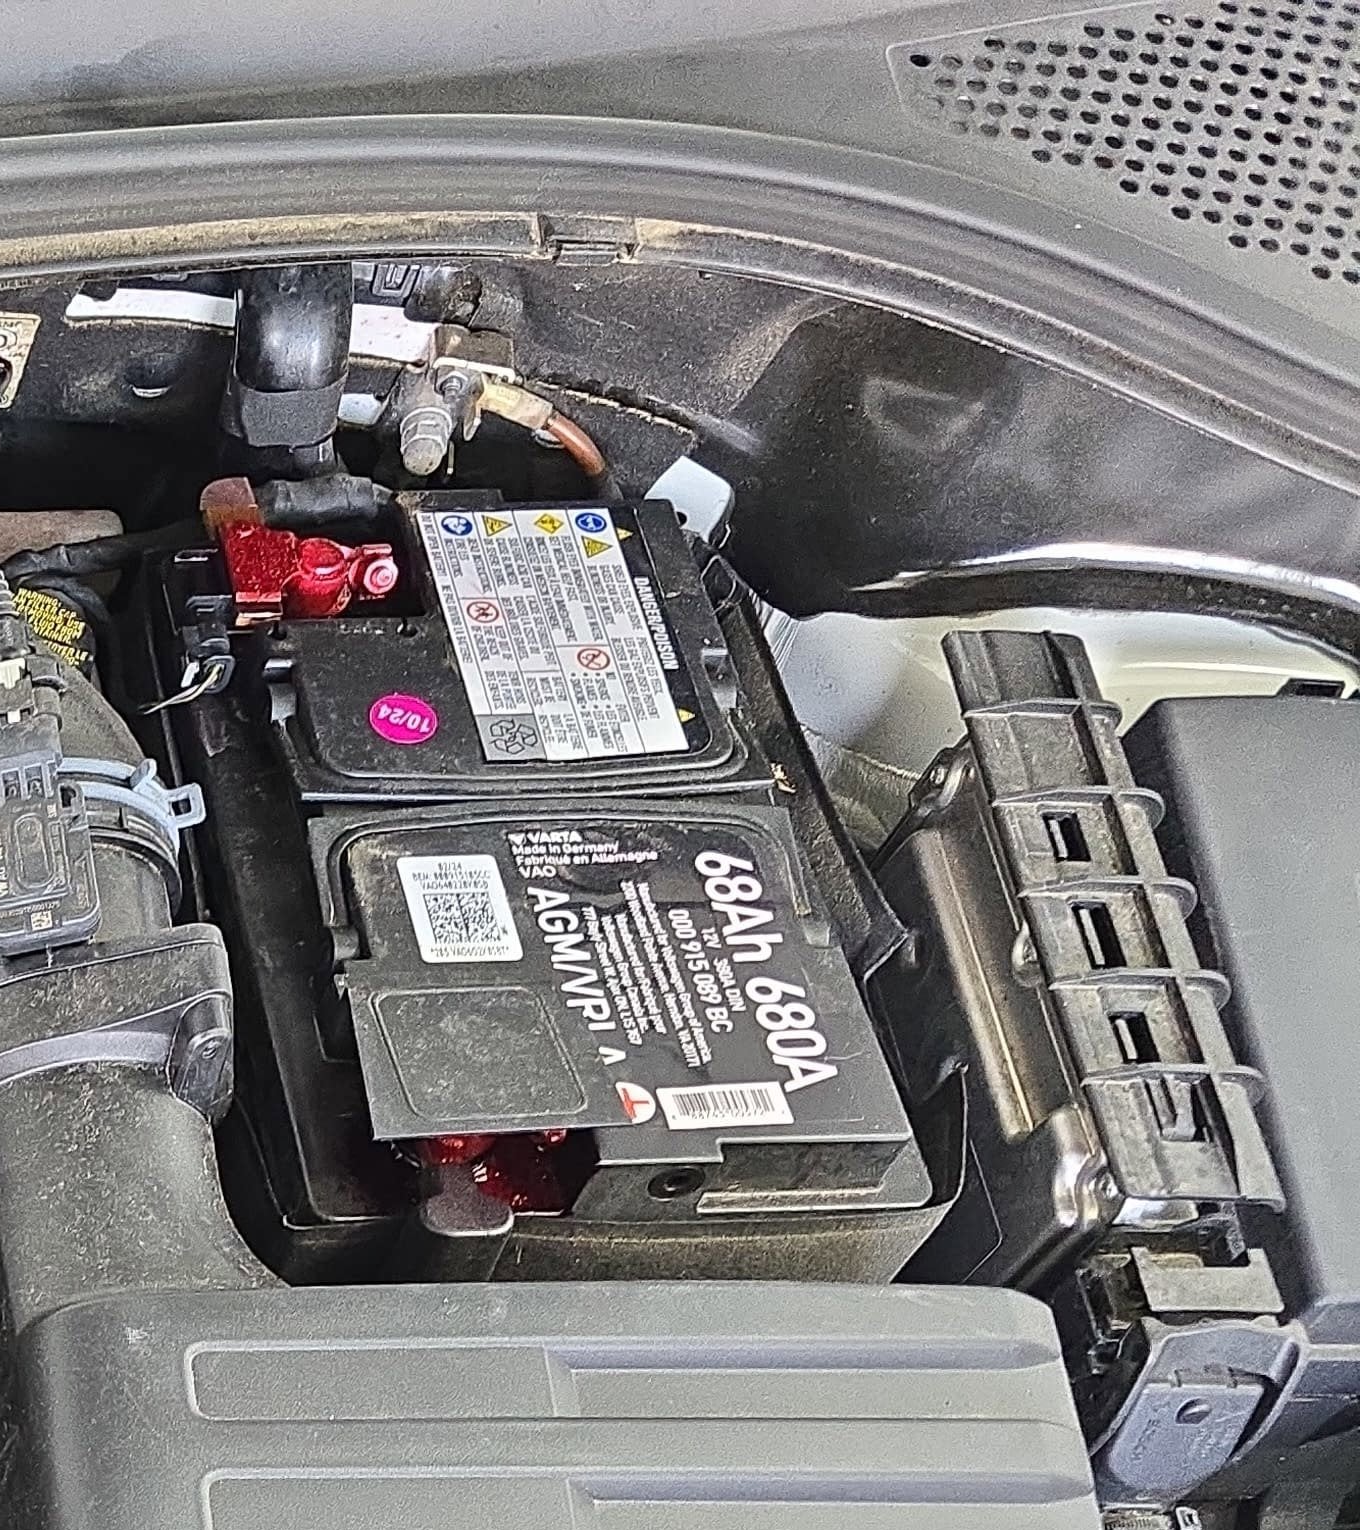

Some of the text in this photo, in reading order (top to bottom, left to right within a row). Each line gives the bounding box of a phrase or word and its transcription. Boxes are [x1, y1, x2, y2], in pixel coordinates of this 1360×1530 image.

[632, 576, 679, 670] DANGER/POISON
[377, 703, 430, 733] 10/24
[512, 841, 619, 854] Made in Germany
[527, 831, 582, 844] VARTA
[572, 857, 590, 865] en
[592, 850, 658, 865] Allemagne
[519, 865, 557, 878] VAO
[613, 962, 636, 987] Group
[665, 908, 735, 1033] 000 915 089 BC
[695, 851, 838, 1093] 68Ah 680A
[699, 927, 722, 948] 12V
[723, 987, 748, 1012] DIN
[674, 992, 699, 1017] Group
